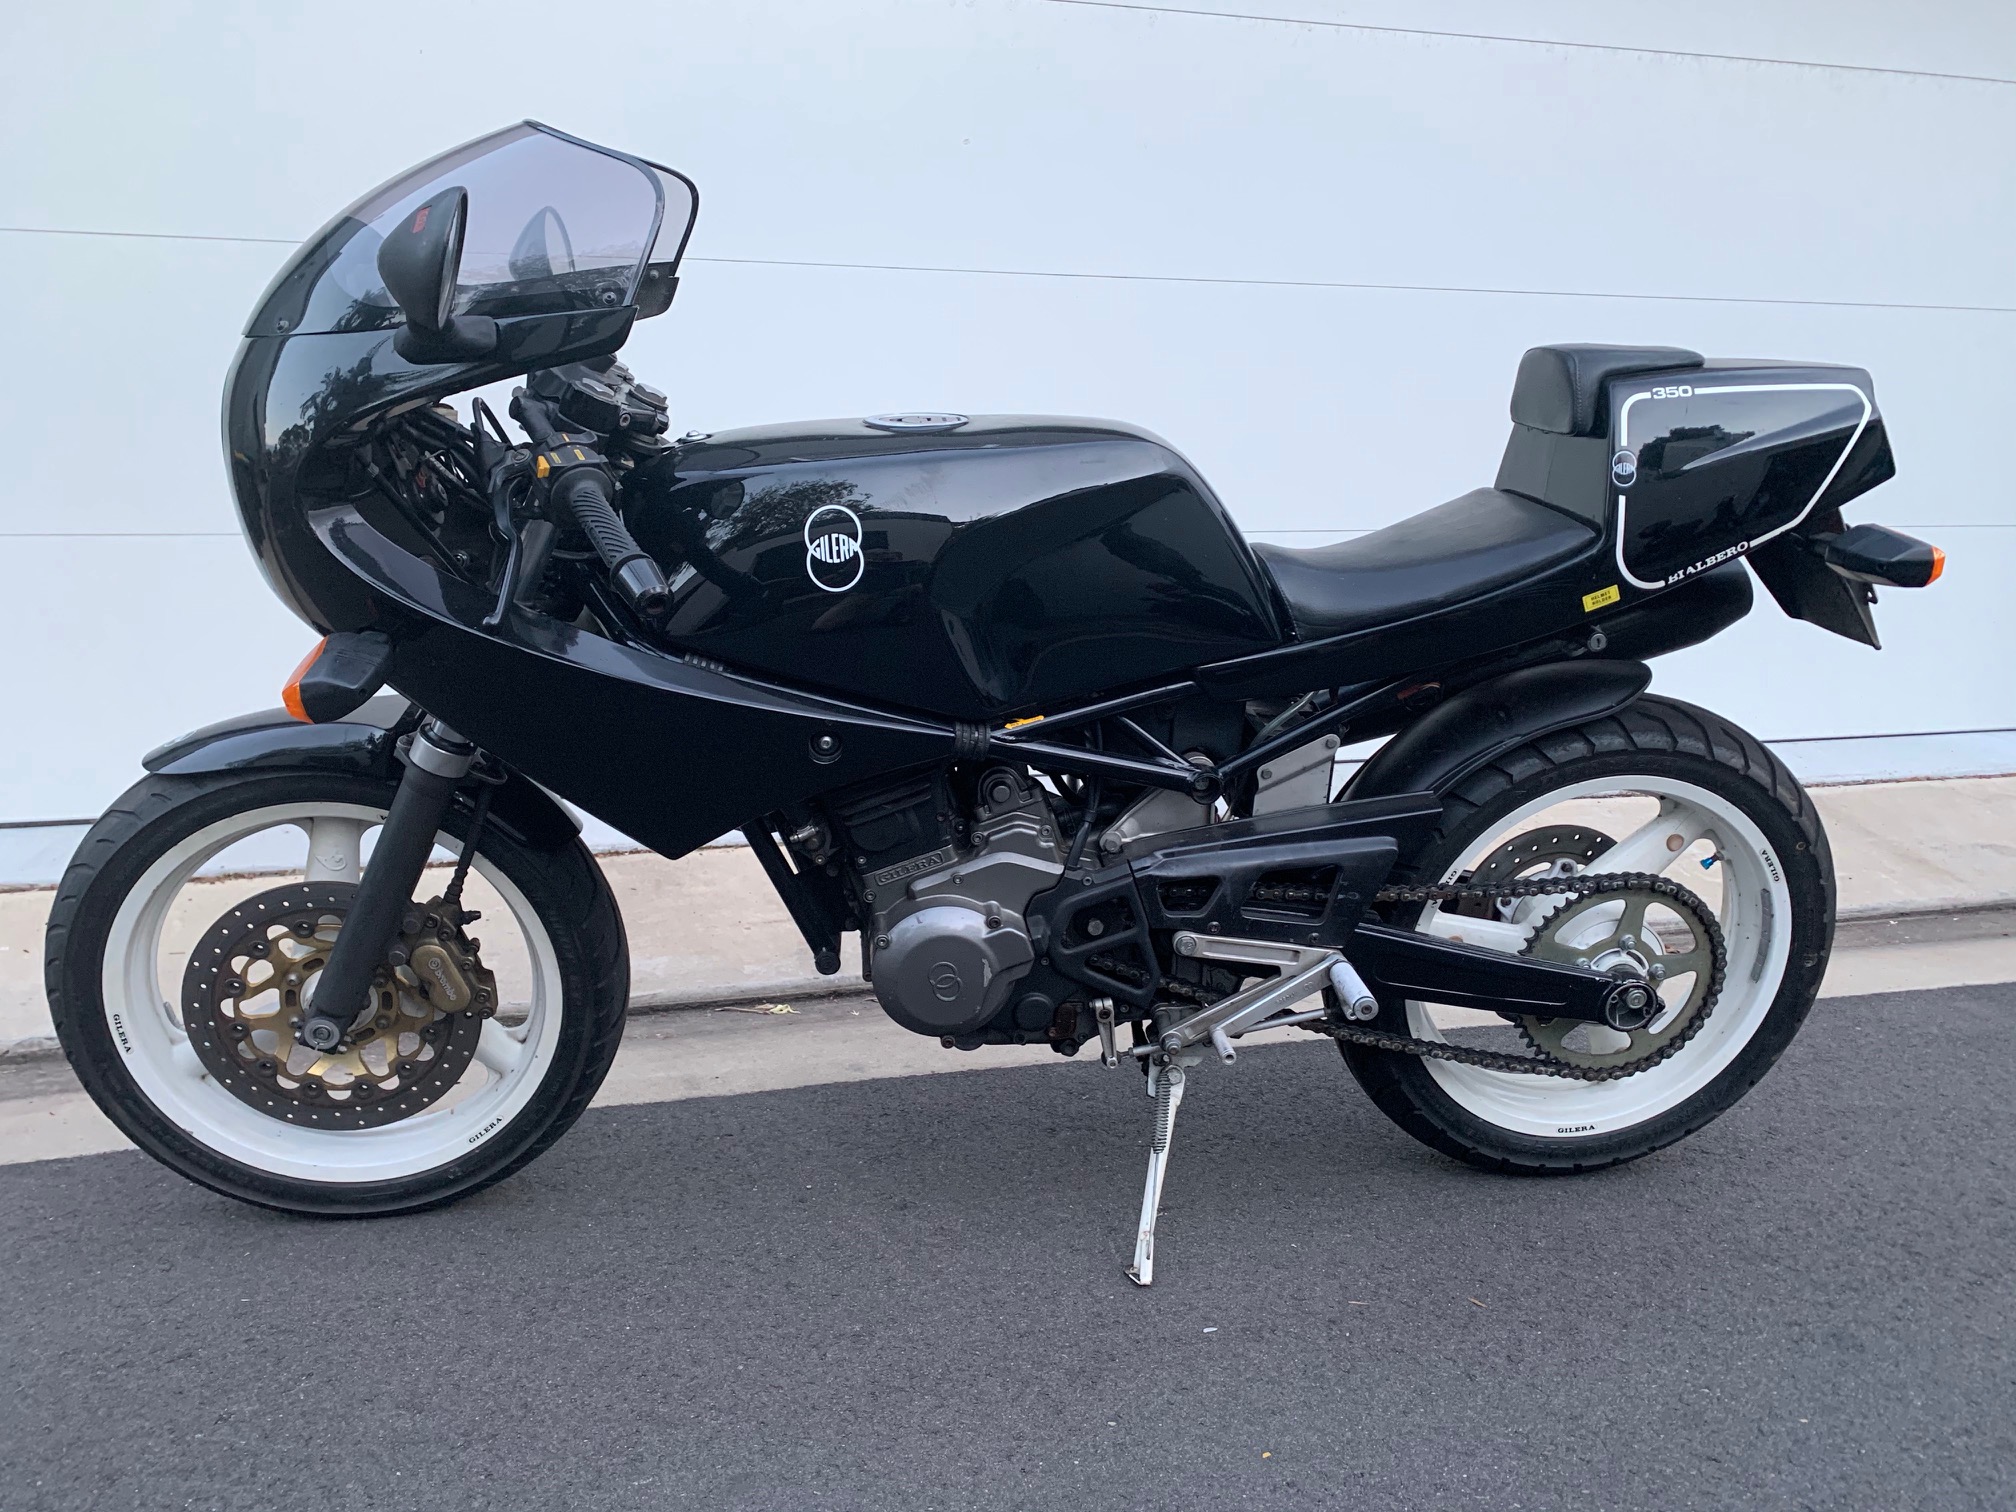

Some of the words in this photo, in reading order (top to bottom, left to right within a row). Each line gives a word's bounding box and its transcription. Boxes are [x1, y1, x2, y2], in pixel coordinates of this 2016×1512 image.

[1652, 385, 1693, 399] 350
[809, 533, 860, 563] GILERA
[879, 856, 941, 882] GILERA
[1761, 850, 1780, 882] GILERA
[113, 1013, 132, 1053] GILERA
[468, 1117, 502, 1143] GILERA
[1557, 1124, 1595, 1134] GILERA
